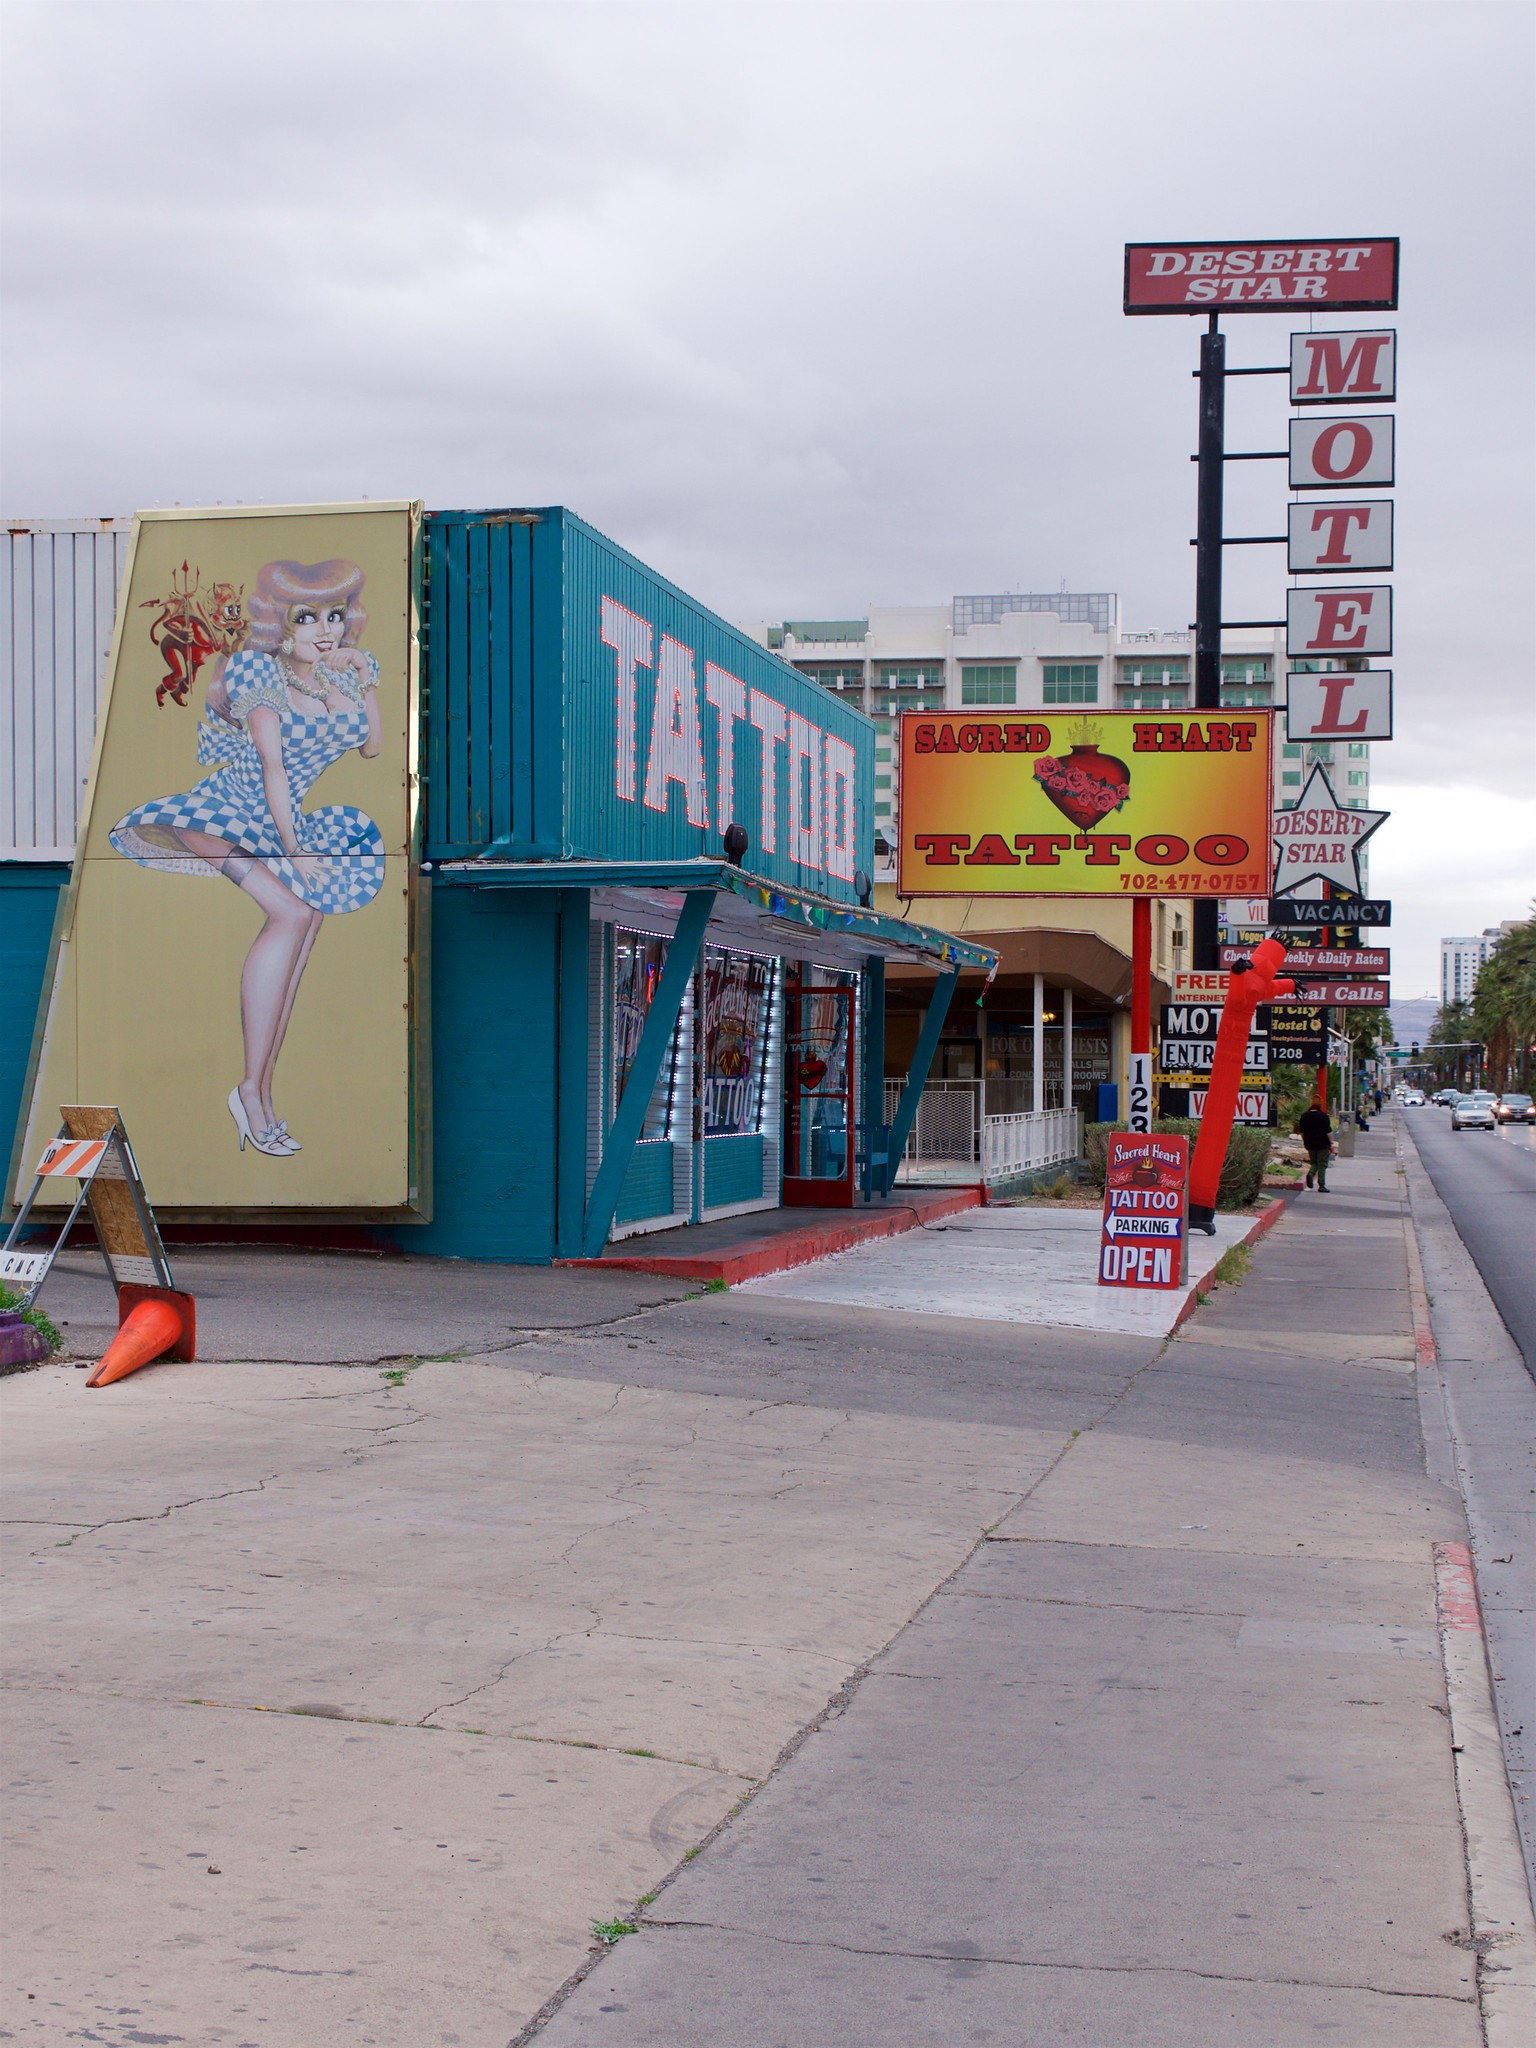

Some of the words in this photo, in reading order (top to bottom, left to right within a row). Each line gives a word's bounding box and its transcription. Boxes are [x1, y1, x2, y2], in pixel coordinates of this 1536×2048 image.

[1146, 248, 1371, 276] DESERT
[1185, 276, 1328, 301] STAR
[1296, 336, 1391, 734] MOTEL
[601, 594, 855, 882] TATTOO
[915, 724, 1051, 753] SACRED
[1133, 722, 1256, 752] HEART
[1274, 809, 1365, 835] DESERT
[915, 834, 1249, 865] TATTOO
[1286, 843, 1346, 863] STAR
[1294, 904, 1385, 920] VACANCY
[1355, 953, 1384, 965] Rates
[1176, 975, 1230, 989] FREE
[1334, 987, 1384, 1000] Calls
[1167, 1007, 1268, 1036] MOTL
[991, 1037, 1017, 1053] FOR
[1022, 1037, 1053, 1053] OR
[1166, 1043, 1265, 1065] ENTRCE
[1272, 1047, 1303, 1059] 1208
[1071, 1060, 1092, 1068] ALLS
[1074, 1071, 1107, 1079] ROOMS
[703, 1078, 754, 1126] ATTOO
[1193, 1093, 1265, 1118] VNCY
[1113, 1143, 1150, 1166] Sacred
[1152, 1143, 1182, 1165] Heart
[1109, 1189, 1179, 1210] TATTOO
[1116, 1219, 1169, 1234] PARKING
[1102, 1245, 1172, 1283] OPEN
